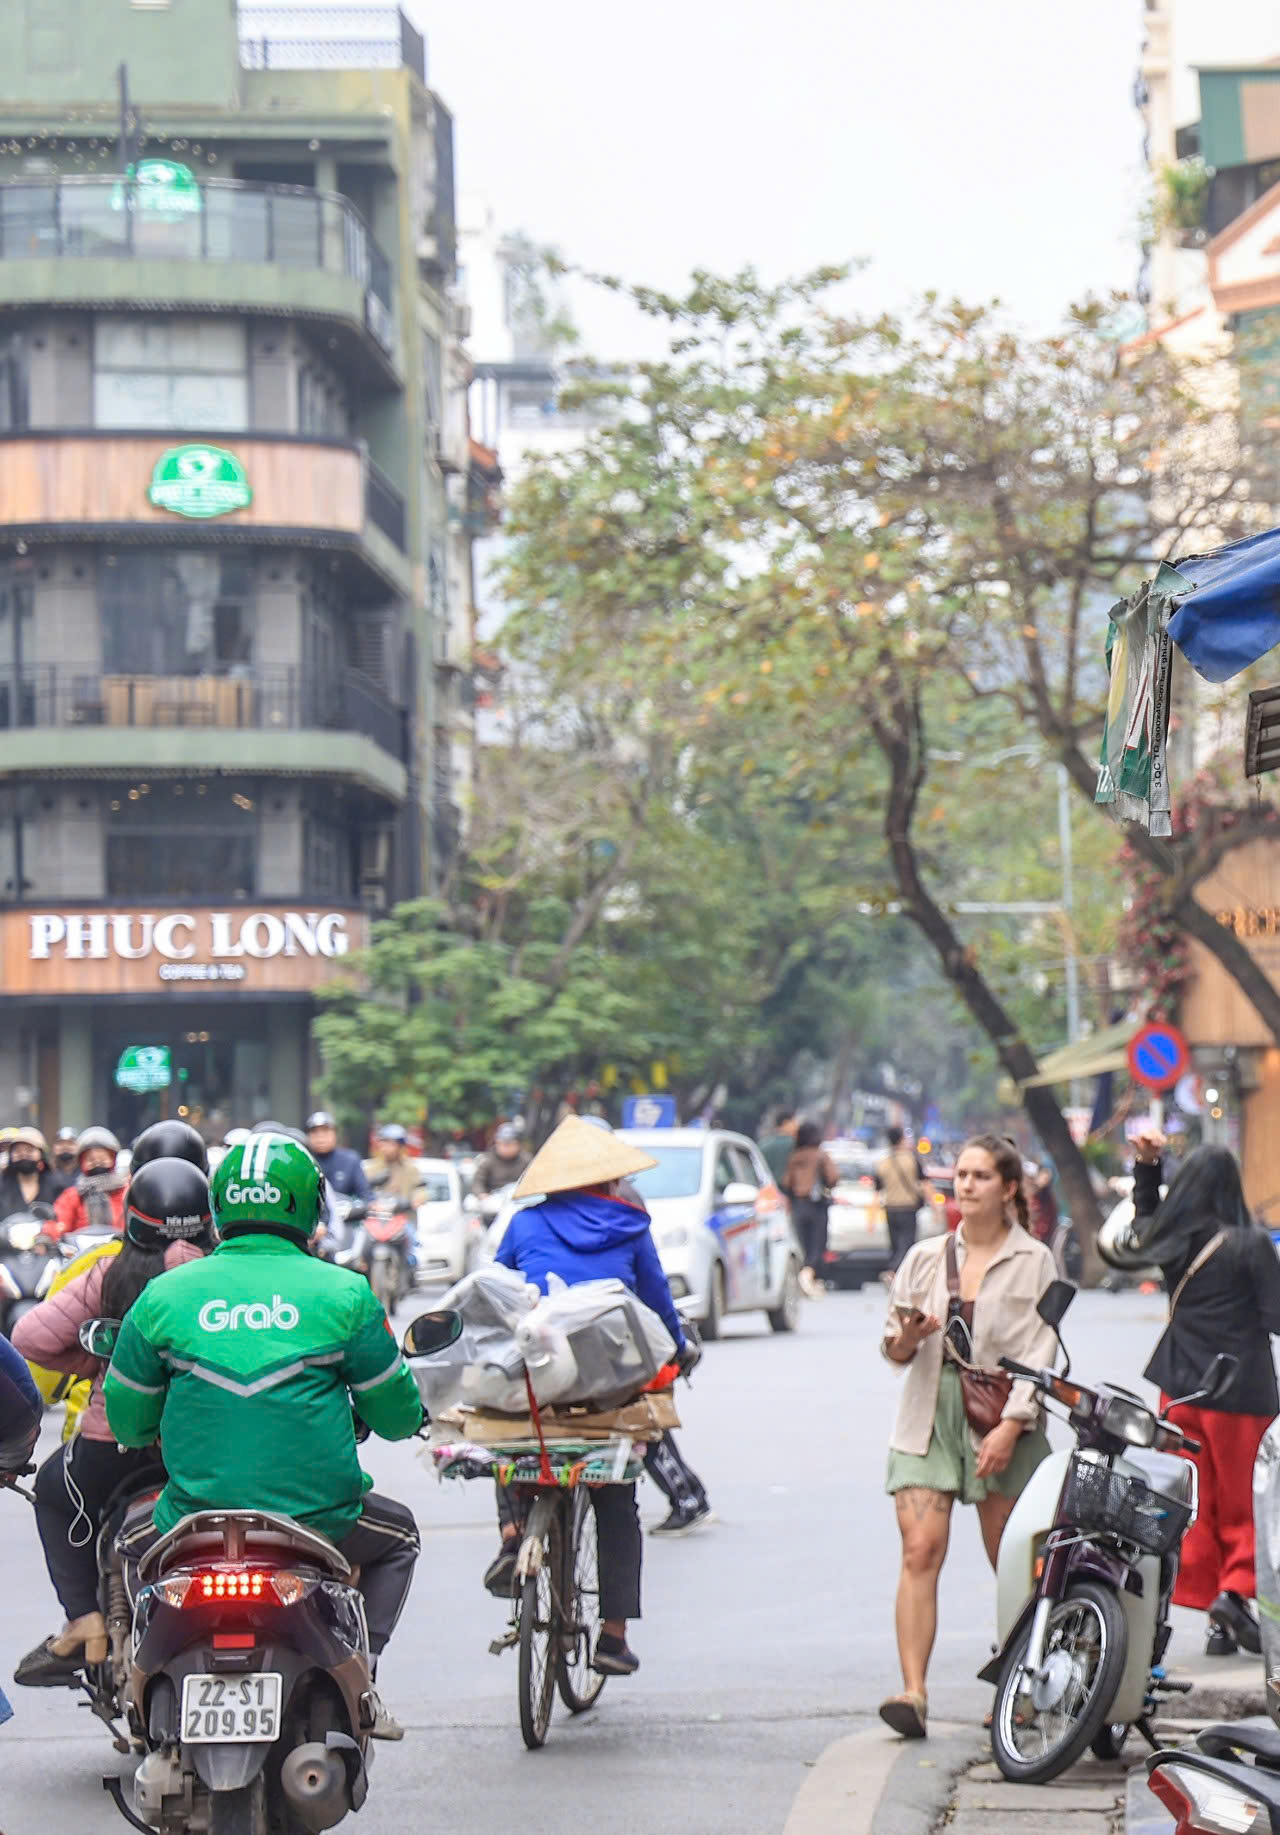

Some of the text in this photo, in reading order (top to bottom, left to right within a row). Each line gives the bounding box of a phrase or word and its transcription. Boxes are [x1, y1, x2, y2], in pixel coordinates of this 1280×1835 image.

[30, 912, 349, 959] PHUC LONG
[225, 1182, 281, 1204] Grab
[199, 1295, 299, 1332] Grab
[198, 1679, 264, 1706] 22-S1
[187, 1708, 274, 1737] 209.95
